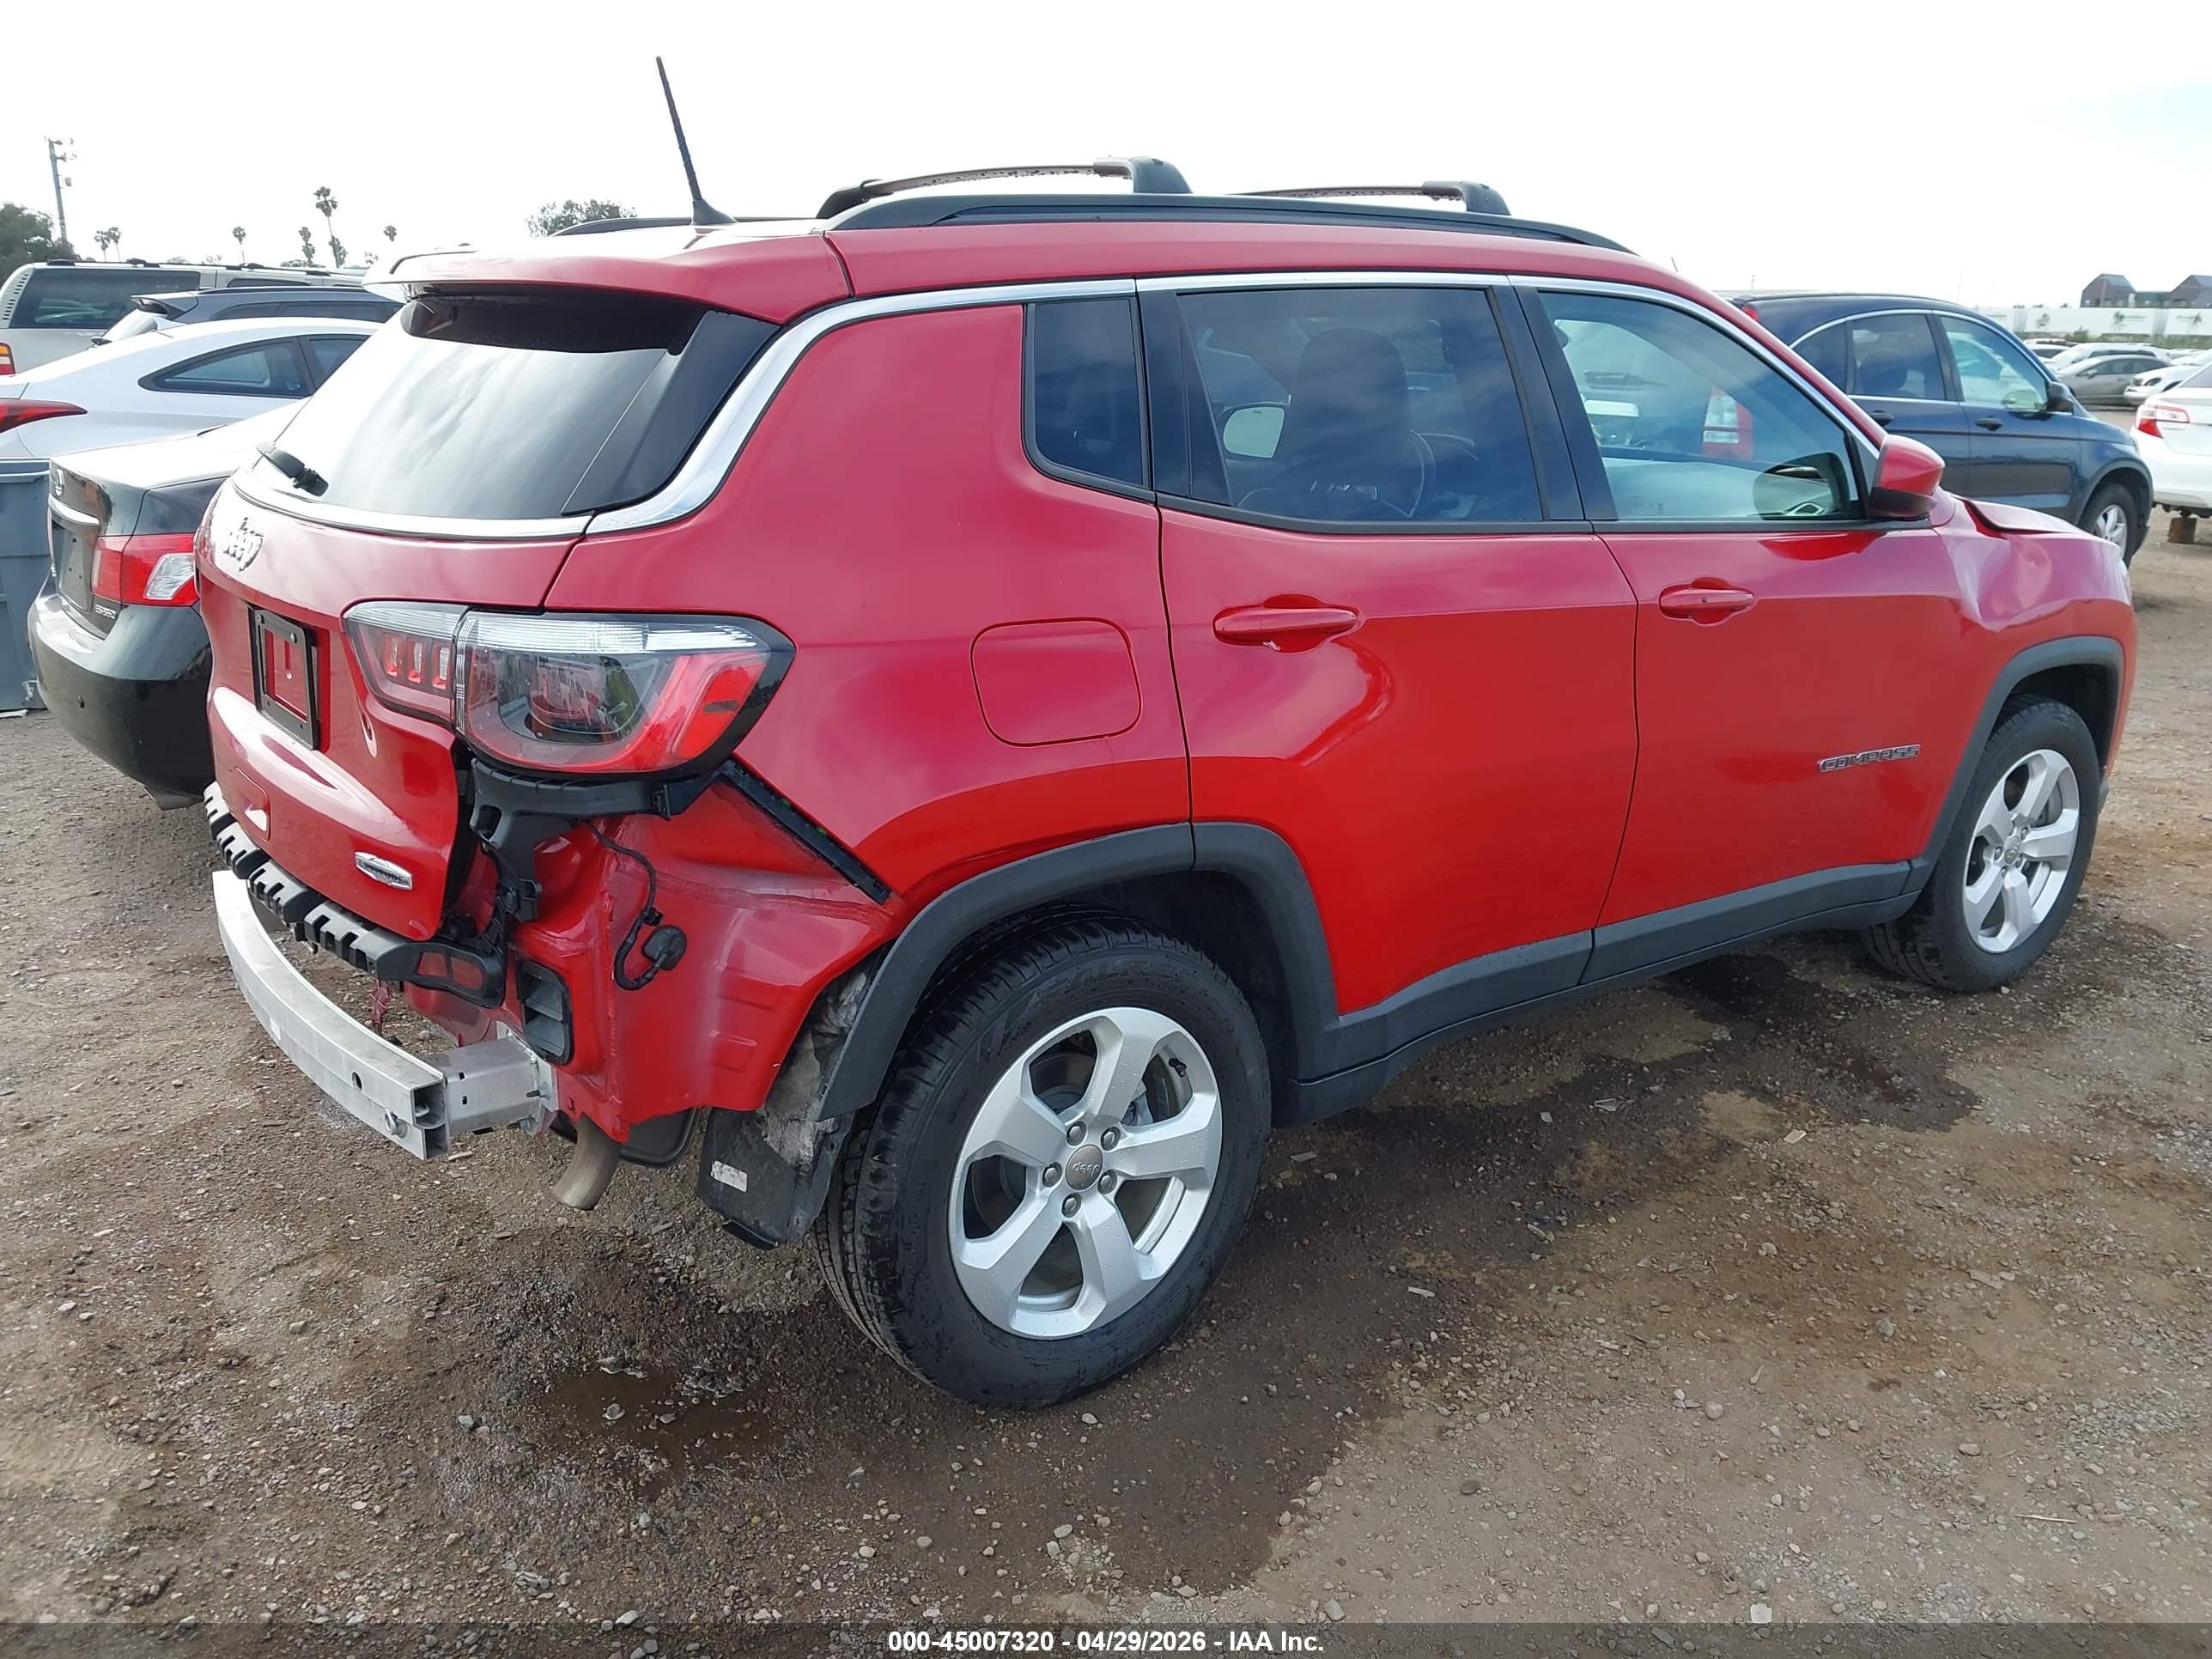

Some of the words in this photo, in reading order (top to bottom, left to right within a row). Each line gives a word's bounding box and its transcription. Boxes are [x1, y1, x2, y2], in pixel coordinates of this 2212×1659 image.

[222, 516, 264, 573] Jeep
[1818, 744, 1922, 773] COMPASS
[1071, 1160, 1100, 1177] Jeep
